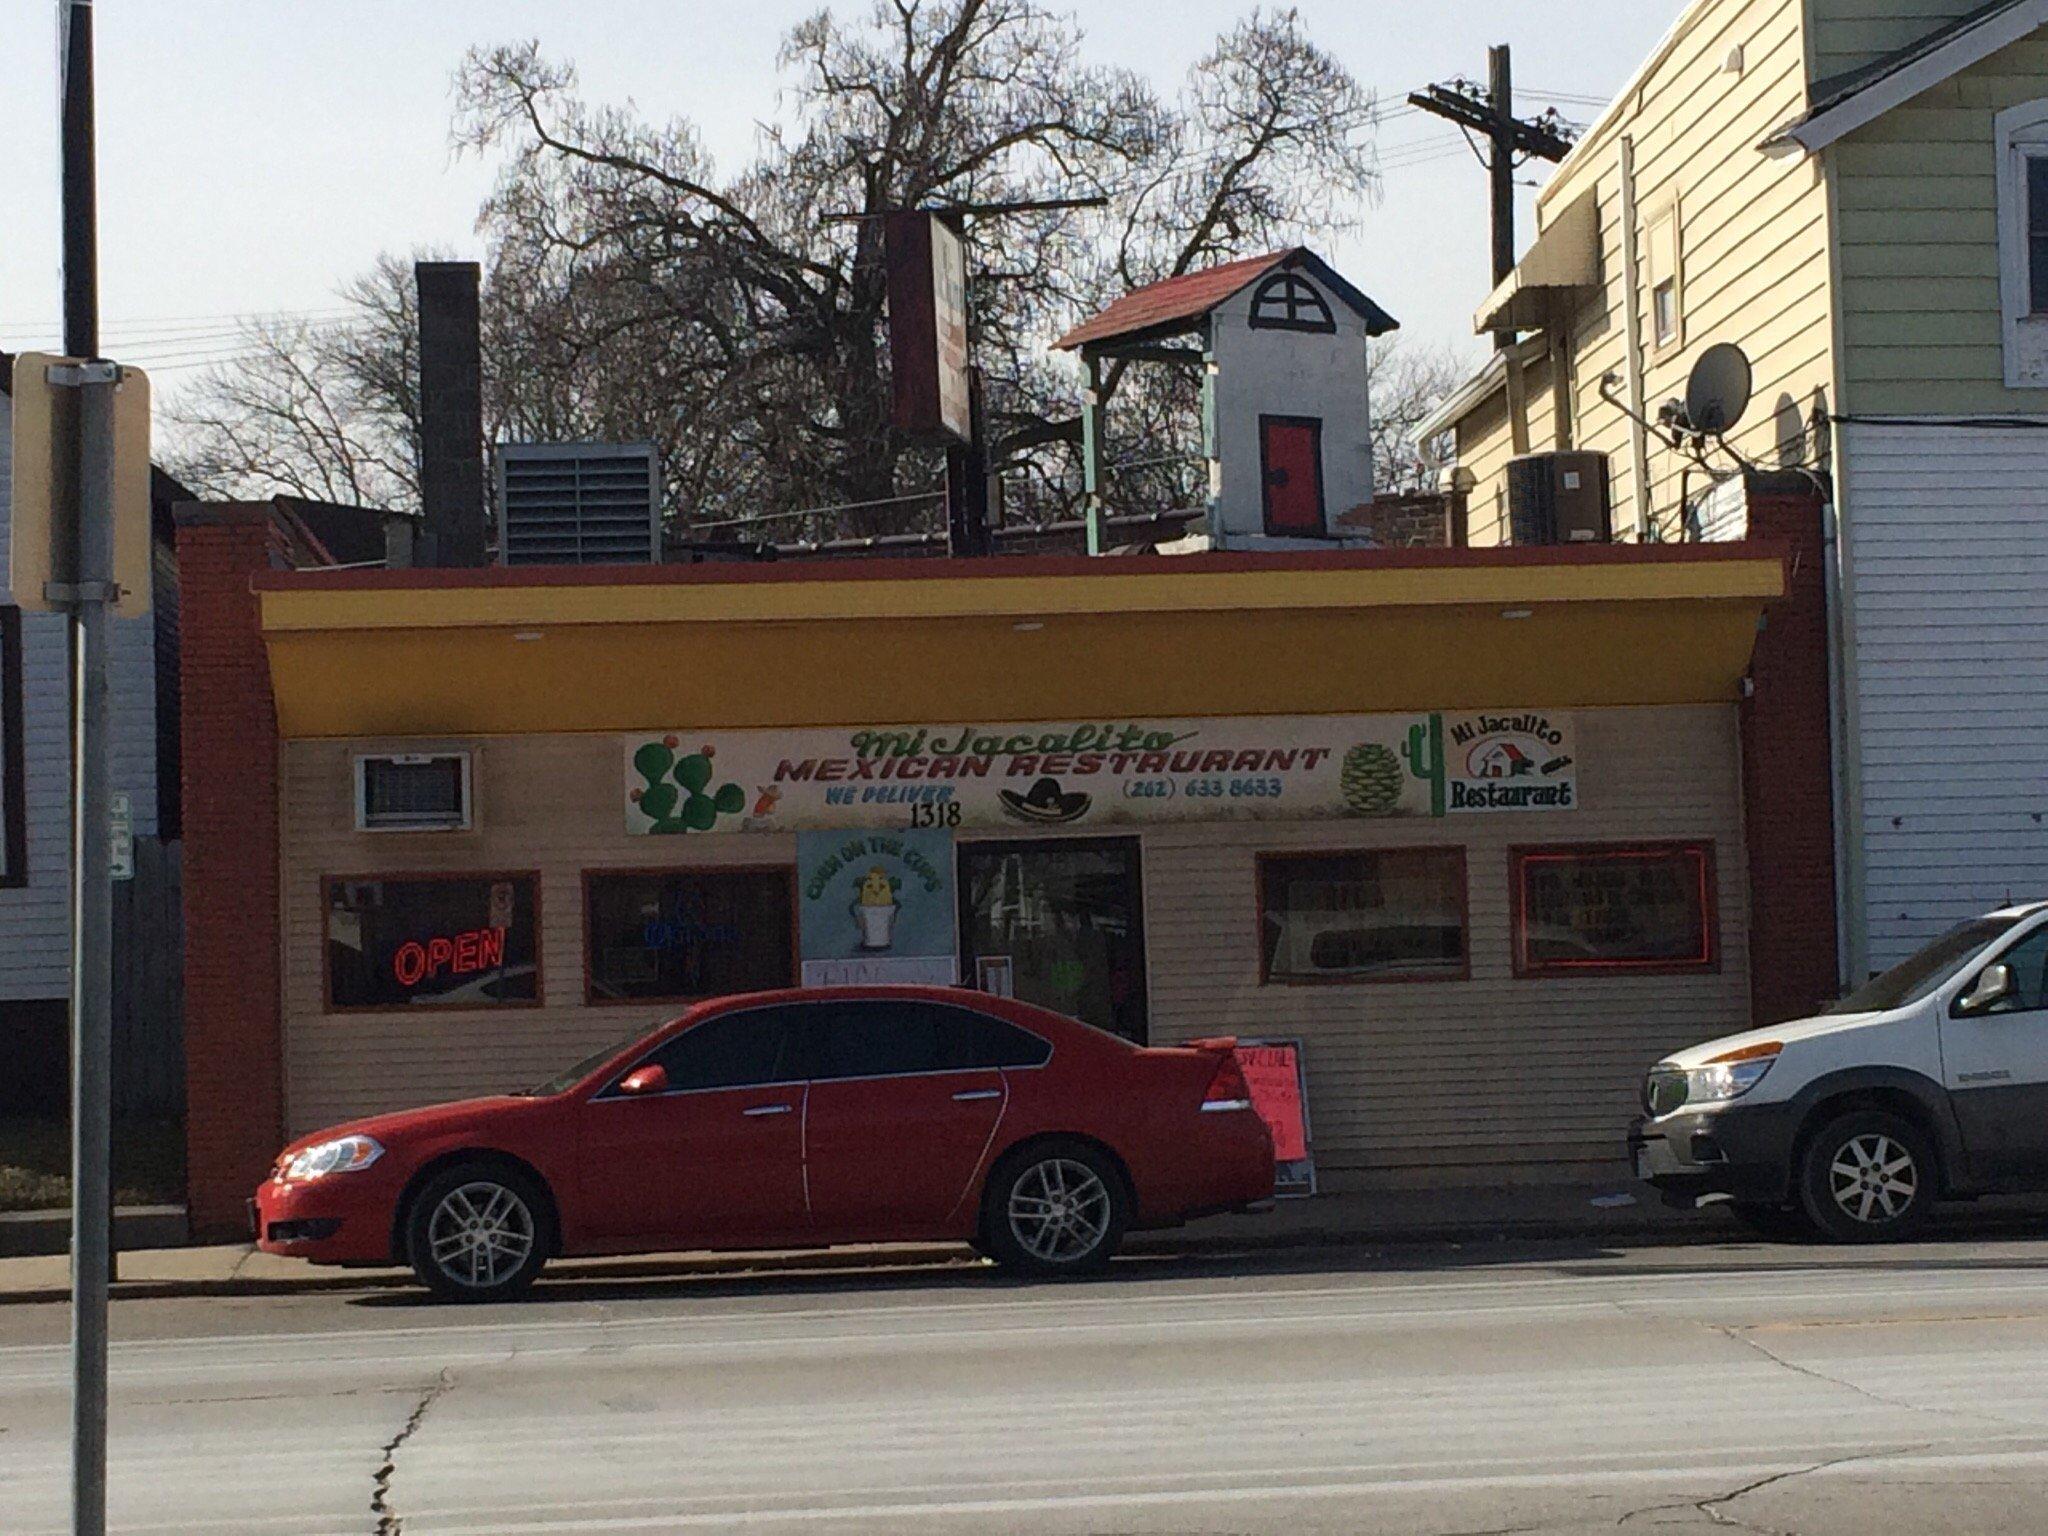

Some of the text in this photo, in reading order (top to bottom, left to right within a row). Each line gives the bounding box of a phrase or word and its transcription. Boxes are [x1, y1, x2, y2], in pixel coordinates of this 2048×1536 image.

[1478, 714, 1562, 746] Jacalito
[774, 749, 1332, 782] MEXICAN RESTAURANT
[825, 784, 956, 805] WE DELIVER
[1449, 780, 1572, 808] Restaurant
[911, 801, 962, 829] 1318
[393, 925, 507, 987] OPEN
